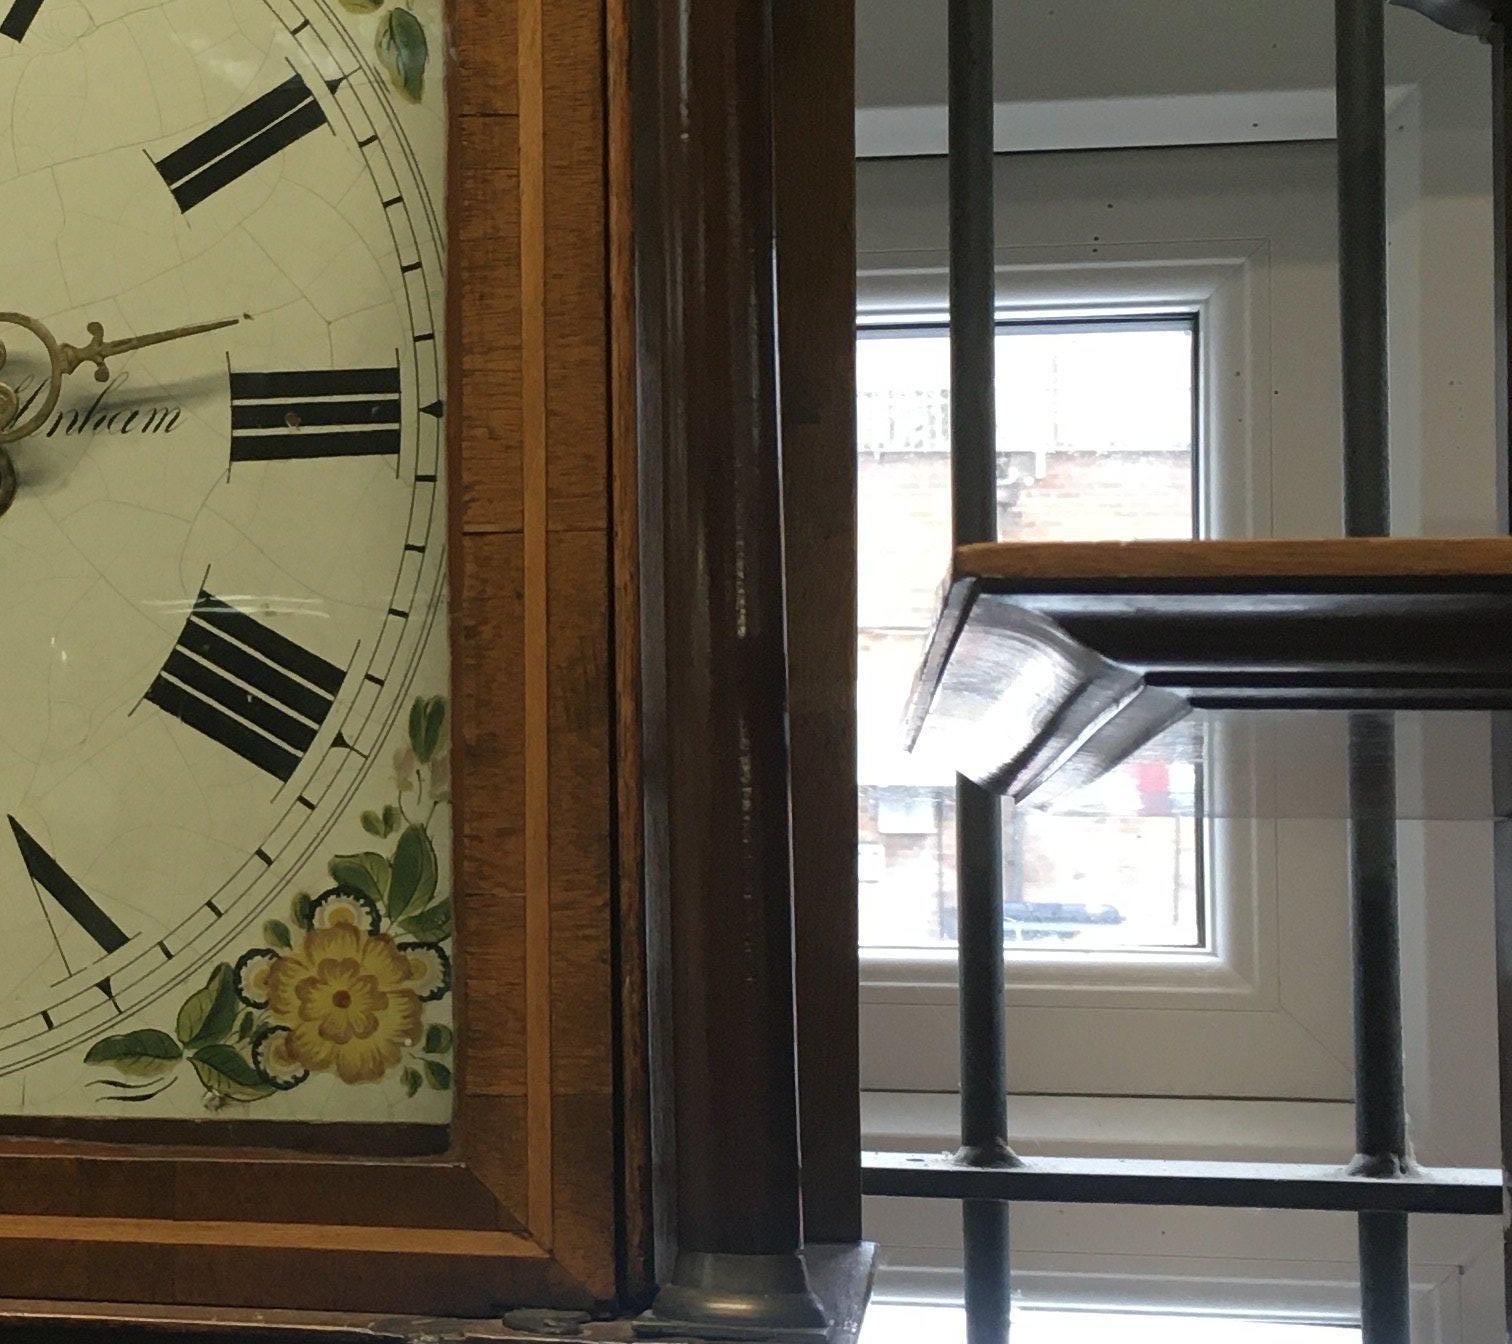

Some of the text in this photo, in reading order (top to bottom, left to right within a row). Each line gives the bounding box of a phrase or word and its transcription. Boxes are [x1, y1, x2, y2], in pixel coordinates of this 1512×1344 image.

[142, 56, 337, 217] II
[226, 348, 401, 490] III
[128, 563, 361, 804] IIII
[7, 813, 142, 988] V
